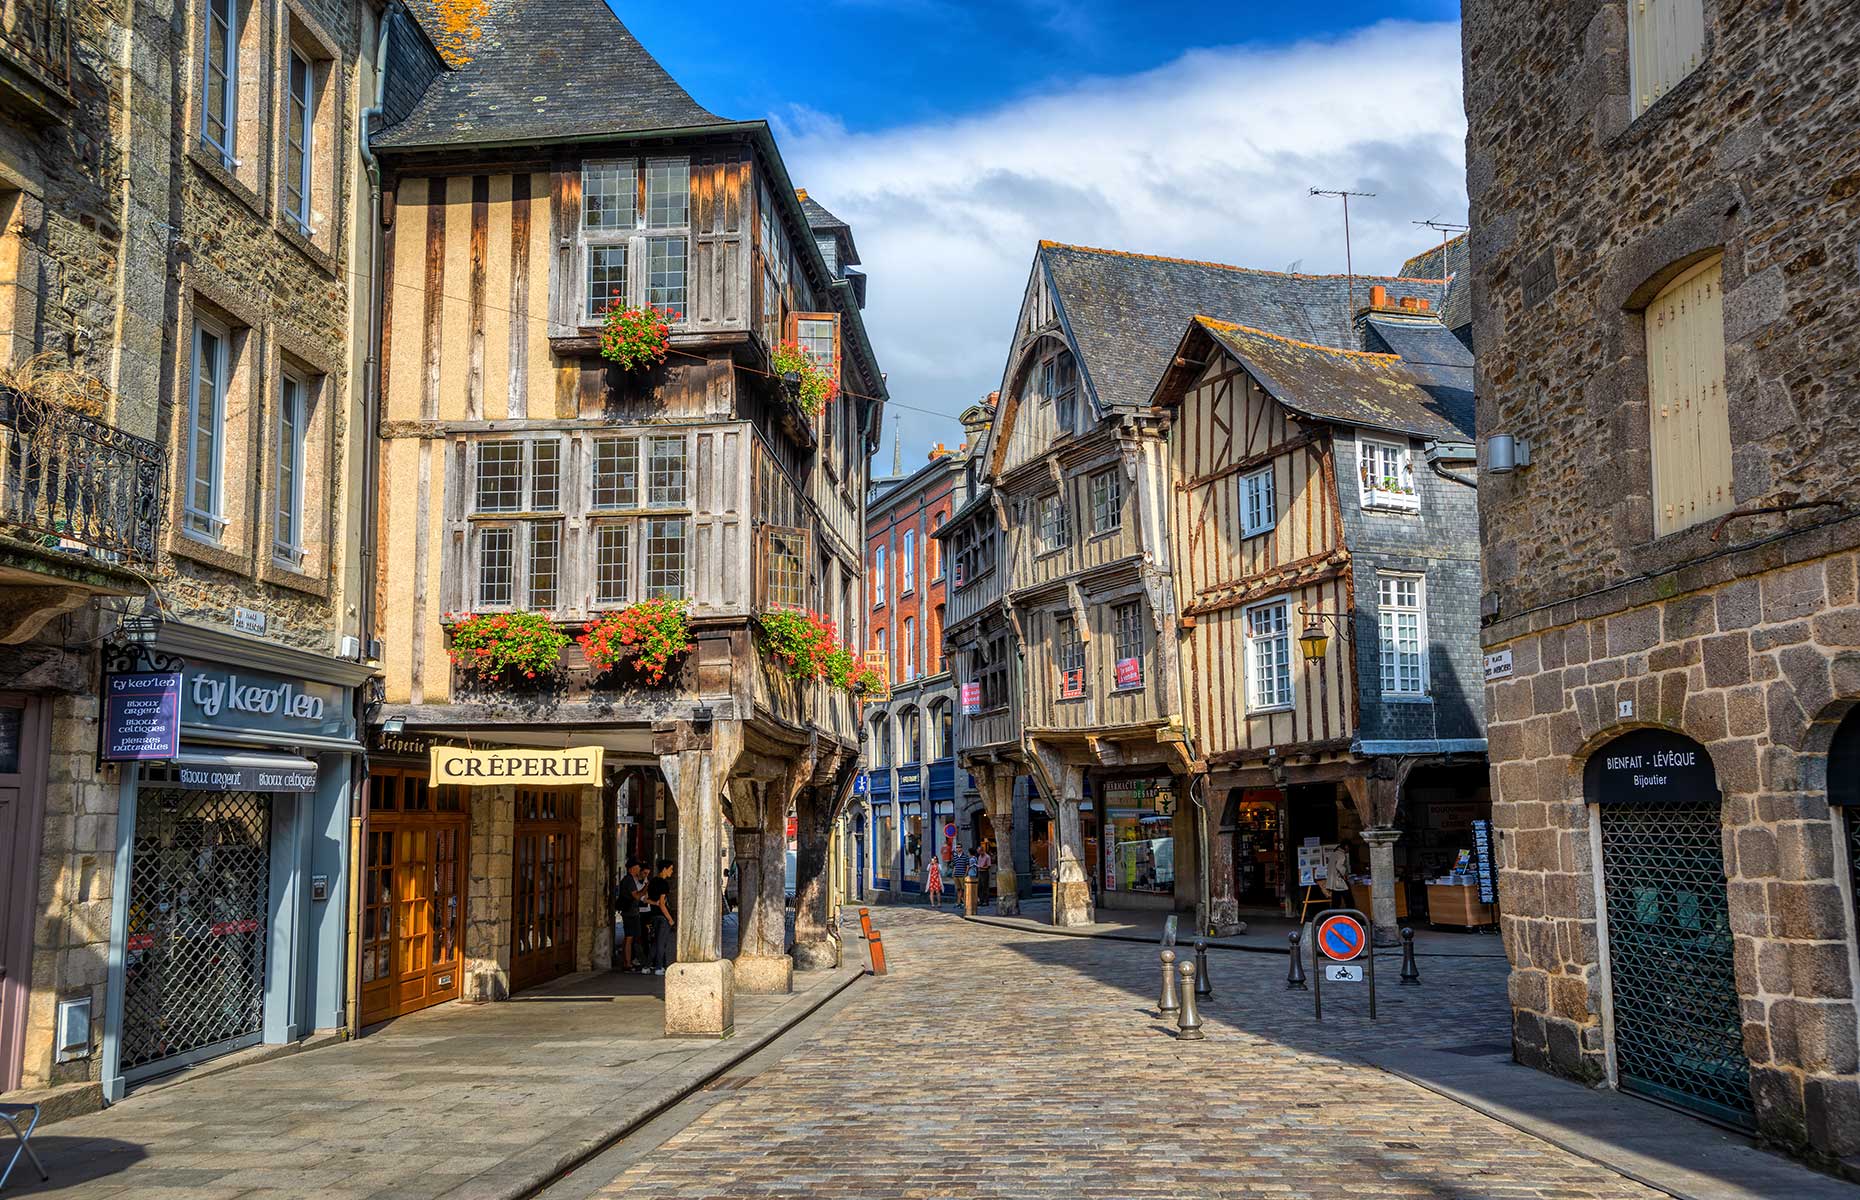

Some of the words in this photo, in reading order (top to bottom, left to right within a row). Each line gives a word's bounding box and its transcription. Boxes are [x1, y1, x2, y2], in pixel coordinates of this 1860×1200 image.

[113, 680, 127, 690] ty
[191, 673, 226, 716] ty
[123, 707, 161, 716] argent
[118, 725, 166, 734] celtiques
[113, 742, 169, 752] naturelles
[121, 737, 161, 746] pierres
[444, 754, 590, 777] CRÊPERIE
[1606, 755, 1643, 770] BIENFAIT
[1652, 750, 1696, 767] LÉVÊQUE
[210, 771, 242, 789] argent
[284, 772, 316, 790] celtiques
[1633, 774, 1668, 788] Bijoutier
